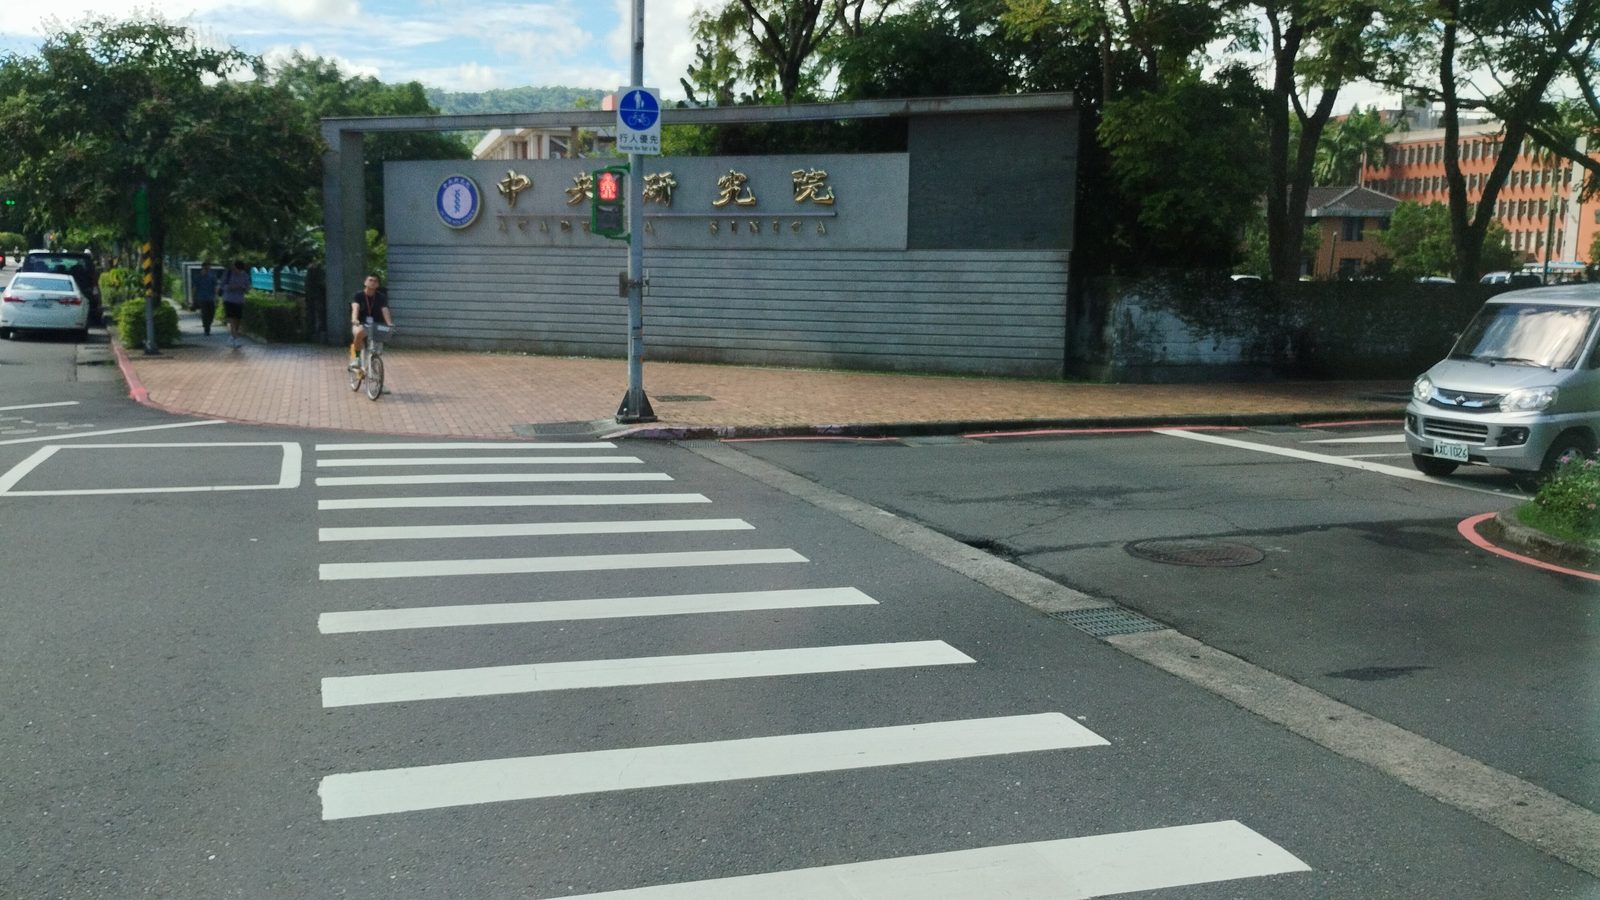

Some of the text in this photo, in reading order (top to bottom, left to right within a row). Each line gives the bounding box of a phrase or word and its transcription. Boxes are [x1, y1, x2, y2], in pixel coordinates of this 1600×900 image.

[619, 134, 659, 144] 行人優先
[499, 219, 827, 234] ACADEA SINICA
